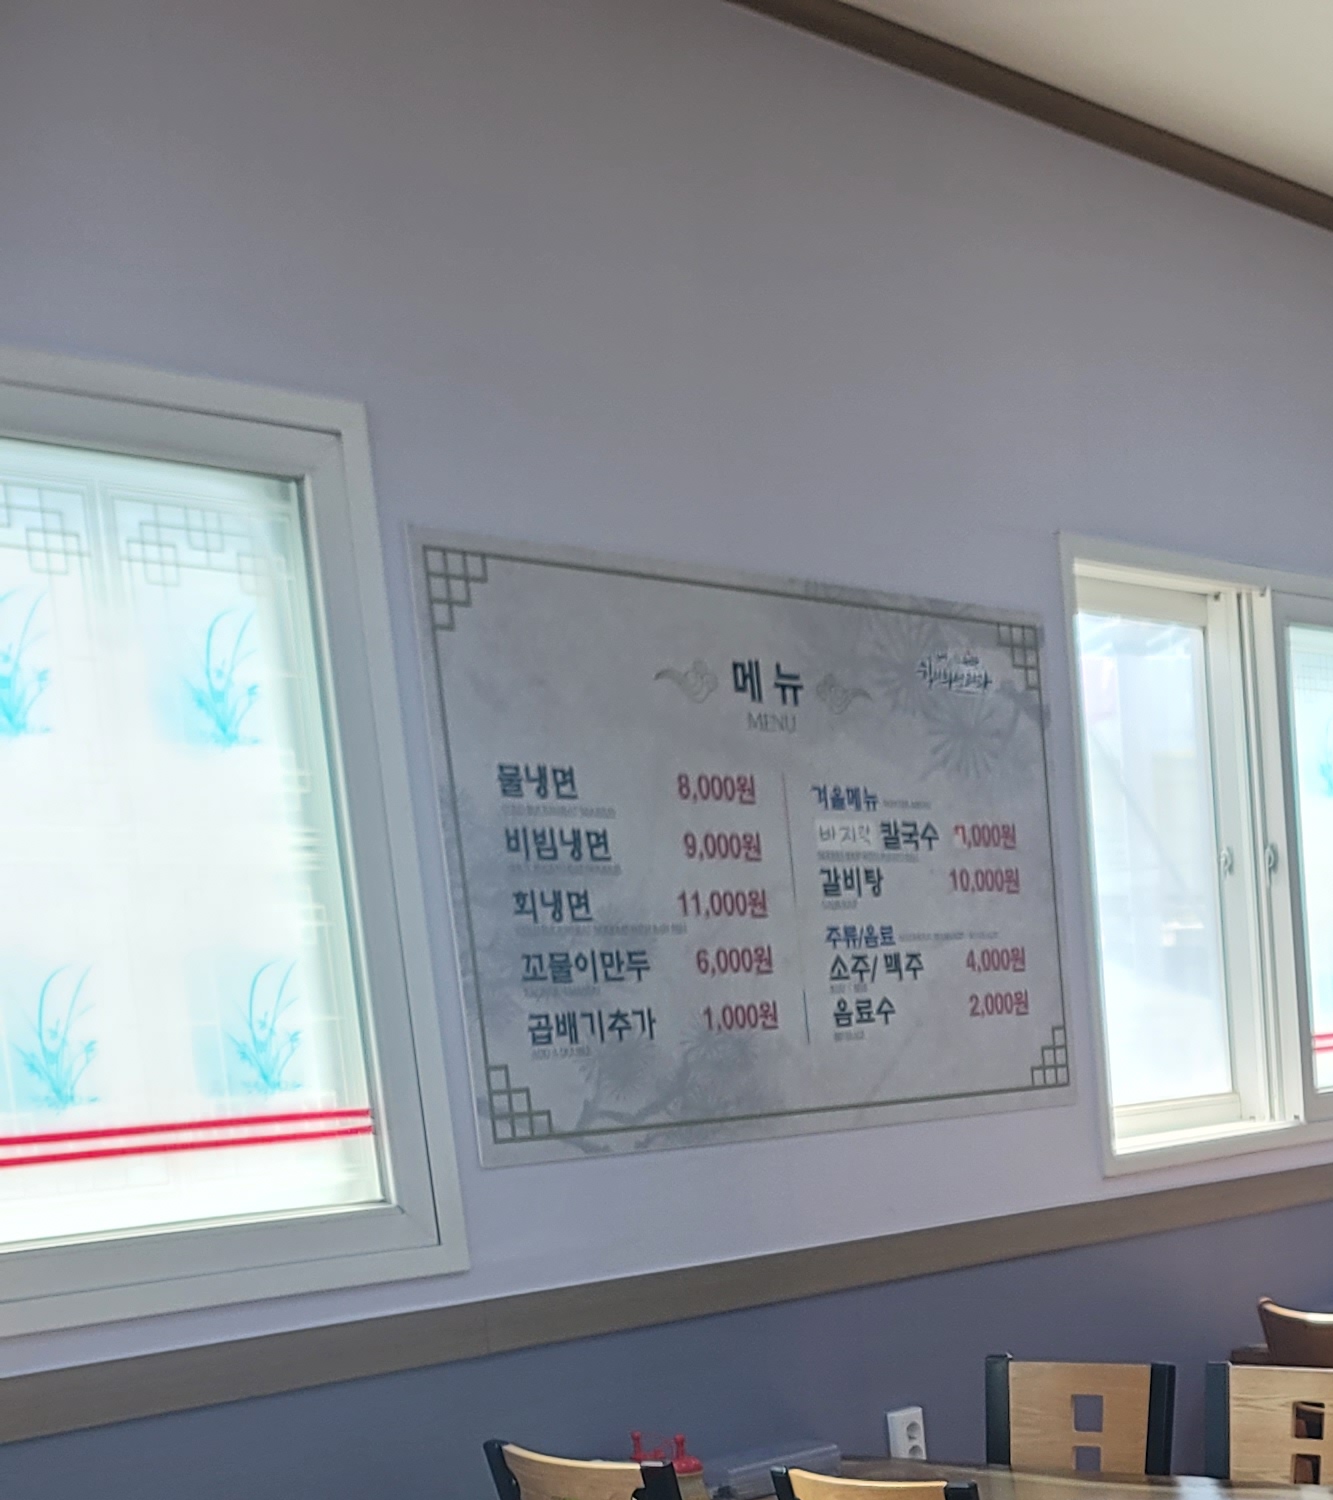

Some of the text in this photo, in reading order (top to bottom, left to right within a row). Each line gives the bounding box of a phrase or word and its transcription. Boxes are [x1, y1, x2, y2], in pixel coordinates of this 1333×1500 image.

[732, 659, 804, 707] 메뉴
[747, 711, 797, 734] MENU
[497, 763, 756, 805] 물냉면 8,000원
[504, 826, 762, 863] 비빔냉면 9,000원
[880, 820, 940, 851] 칼국수
[819, 866, 1021, 898] 갈비탕 10,000원
[512, 889, 768, 924] 회냉면 11,000원
[825, 924, 896, 949] 주류/음료
[521, 945, 774, 985] 꼬물이만두 6,000원
[966, 946, 1026, 973] 4,000원
[528, 1000, 779, 1046] 곱배기추가 1,000원
[833, 989, 1029, 1028] 음료수 2,000원
